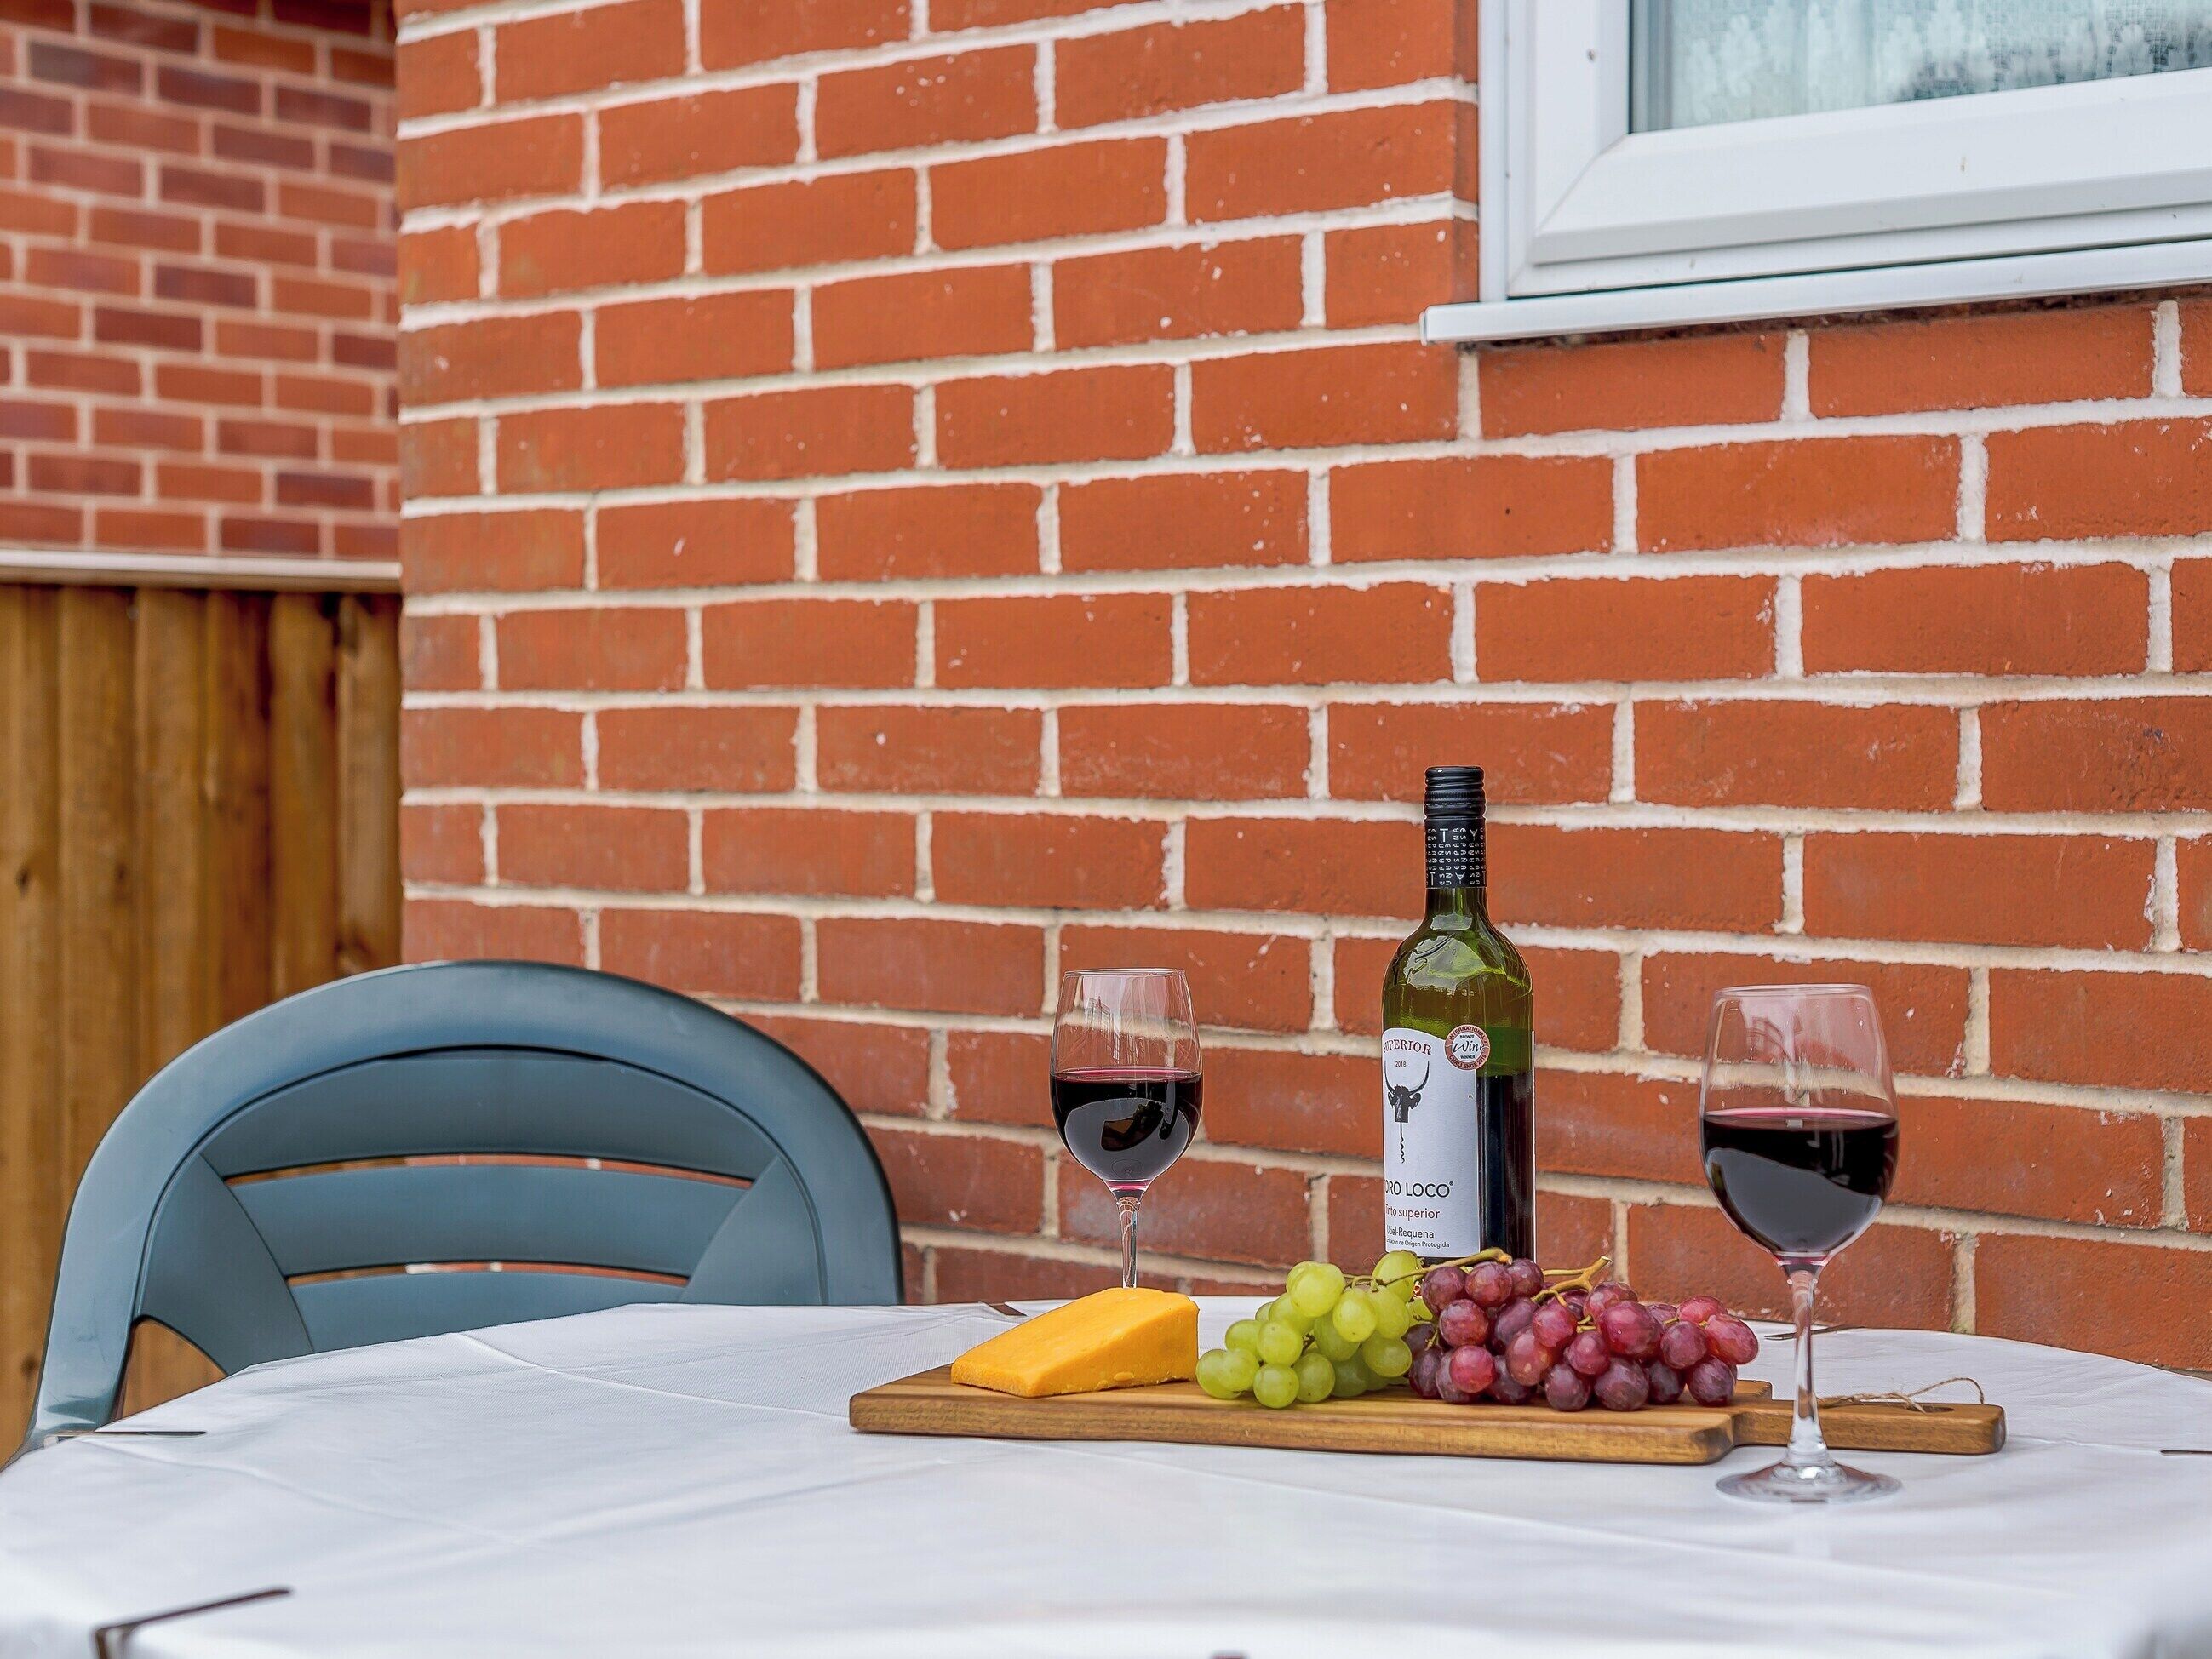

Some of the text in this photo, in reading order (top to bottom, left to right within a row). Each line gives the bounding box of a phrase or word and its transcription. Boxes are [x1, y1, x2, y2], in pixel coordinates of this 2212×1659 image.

[1448, 1026, 1486, 1039] INTERNATIONAL
[1452, 1040, 1485, 1053] Wine
[1449, 1054, 1487, 1069] CHALLENGE 2019
[1385, 1180, 1401, 1196] ORO
[1399, 1208, 1440, 1221] superior
[1422, 1241, 1450, 1250] Protegida
